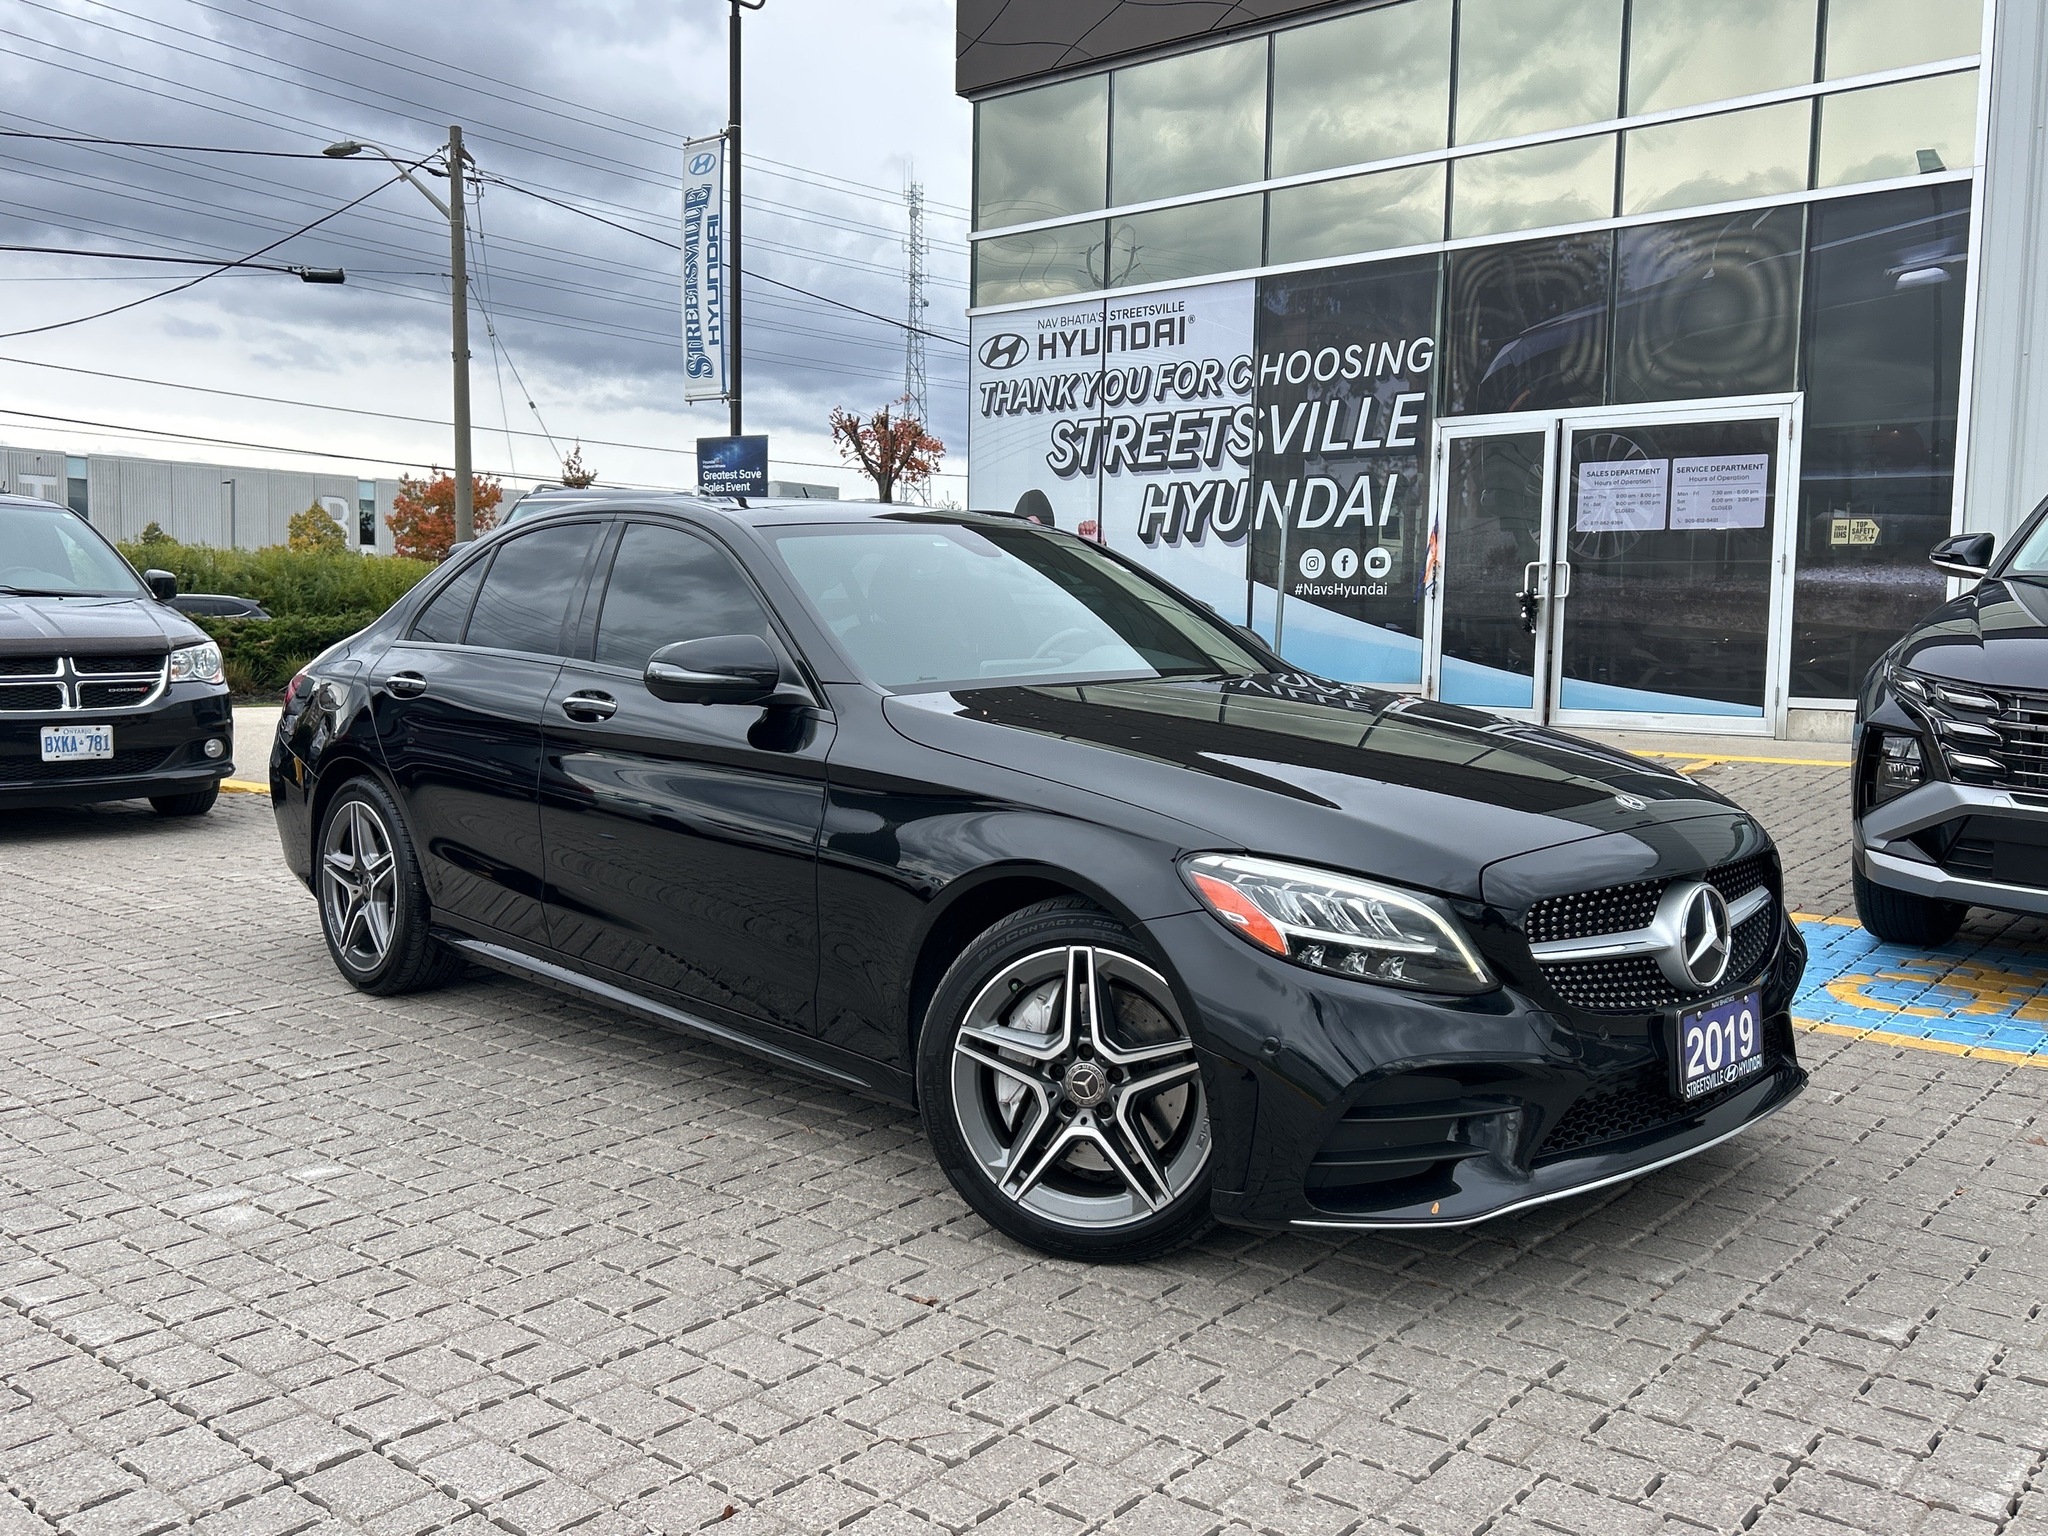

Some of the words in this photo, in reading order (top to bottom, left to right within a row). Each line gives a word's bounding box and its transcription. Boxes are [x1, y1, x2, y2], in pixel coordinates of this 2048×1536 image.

[684, 183, 714, 379] STREETSVILLE
[707, 214, 719, 346] HYUNDAI
[1038, 318, 1058, 330] NAV
[1060, 311, 1106, 328] BHATIA'S
[1109, 301, 1185, 321] STREETSVILLE
[1038, 316, 1186, 361] HYUNDAI
[979, 373, 1082, 418] THANK
[1081, 366, 1152, 409] YOU
[1154, 358, 1226, 402] FOR
[1227, 336, 1435, 396] CHOOSING
[1046, 391, 1426, 478] STREETSVILLE
[703, 470, 738, 480] Greatest
[739, 469, 762, 479] Save
[1586, 470, 1609, 478] SALES
[1610, 467, 1661, 477] DEPARTMENT
[1620, 478, 1652, 487] Operation
[1676, 465, 1709, 474] SERVICE
[1710, 463, 1764, 472] DEPARTMENT
[1688, 475, 1708, 483] Hours
[1716, 474, 1750, 482] Operation
[703, 482, 725, 492] Sales
[725, 482, 751, 492] Event
[1137, 473, 1399, 547] HYUNDAI
[1851, 527, 1875, 535] SAFETY
[1294, 582, 1388, 598] #NavsHyundai
[1687, 1009, 1754, 1079] 2019
[1686, 1069, 1724, 1099] STREETSVILLE
[1738, 1053, 1763, 1077] HYUNDAI
